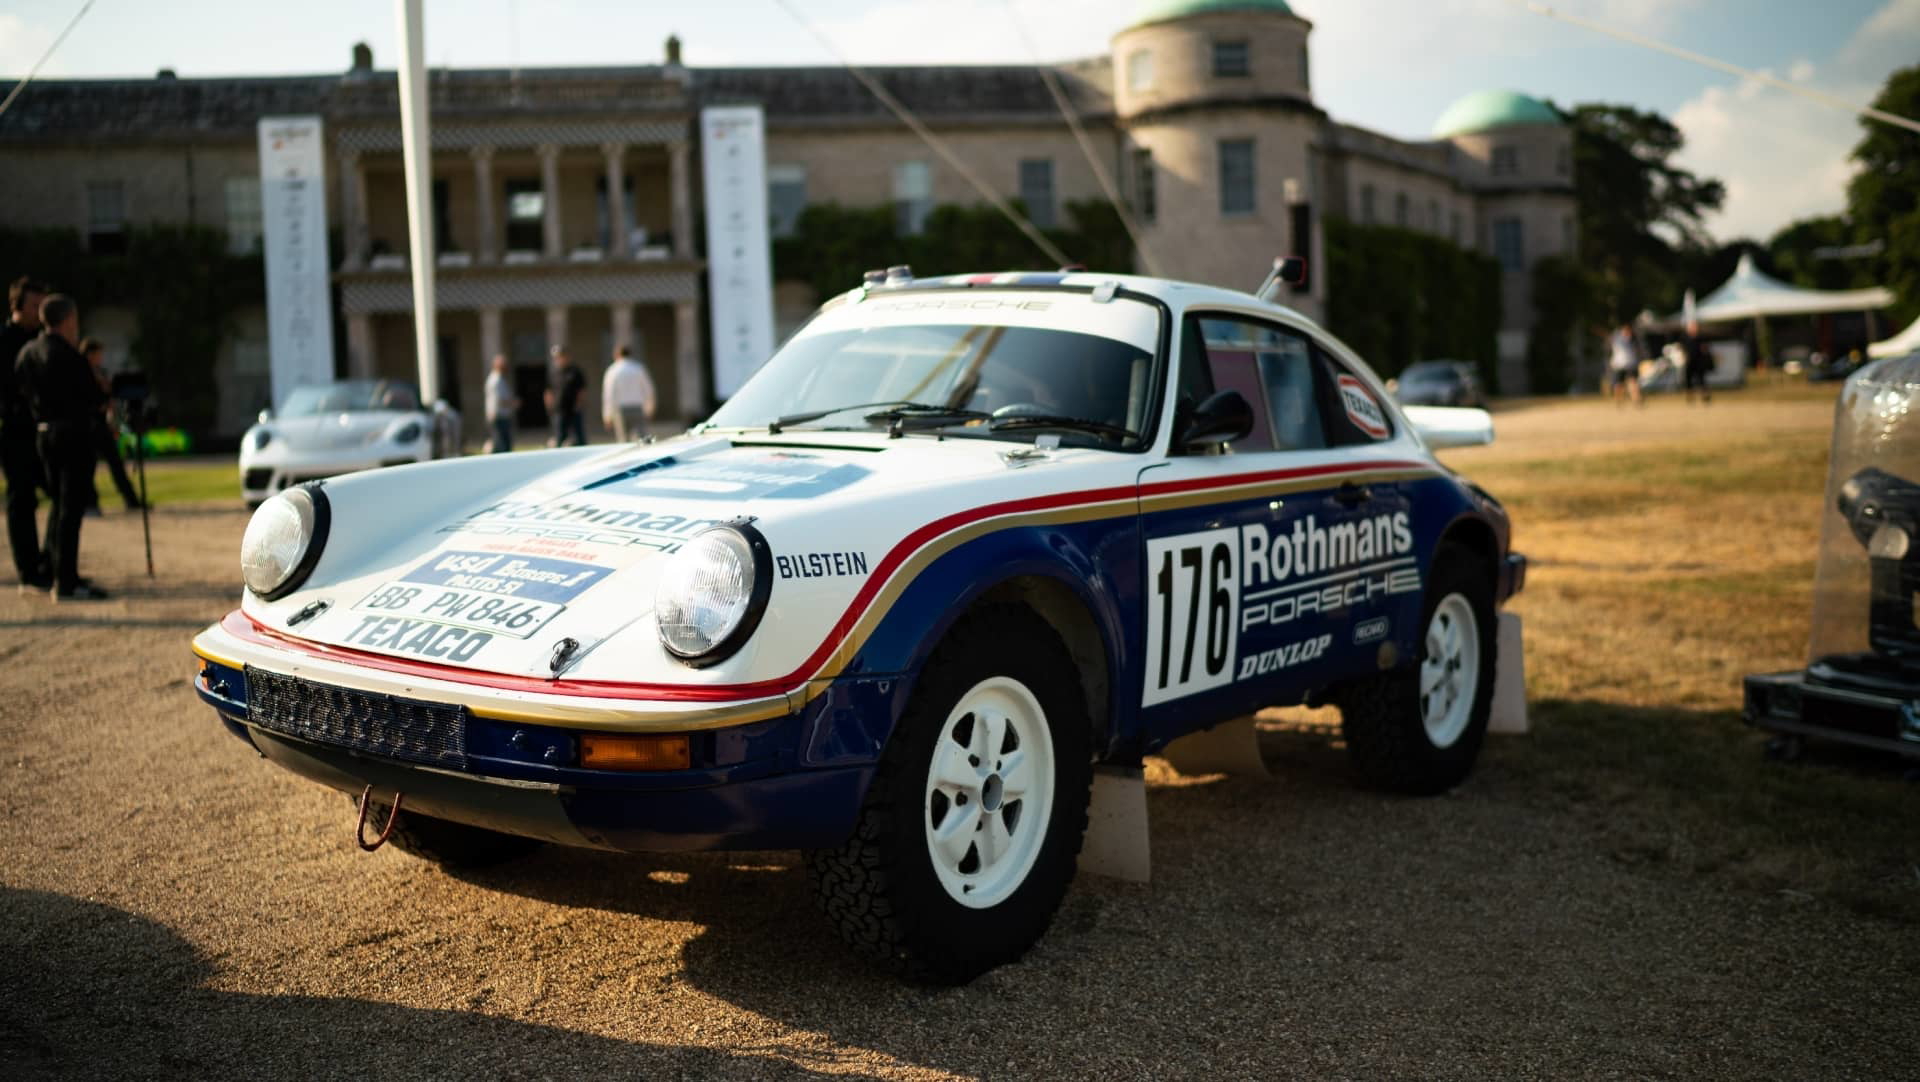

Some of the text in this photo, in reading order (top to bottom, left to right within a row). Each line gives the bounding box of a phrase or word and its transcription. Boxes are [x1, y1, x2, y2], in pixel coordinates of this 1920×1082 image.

[776, 551, 868, 579] BILSTEIN
[1241, 511, 1414, 587] Rothmans
[367, 586, 543, 630] BB PW 846
[1158, 542, 1232, 690] 176
[1242, 568, 1422, 632] PORSCHE
[343, 615, 494, 663] TEXACO
[1236, 634, 1333, 681] DUNLOP
